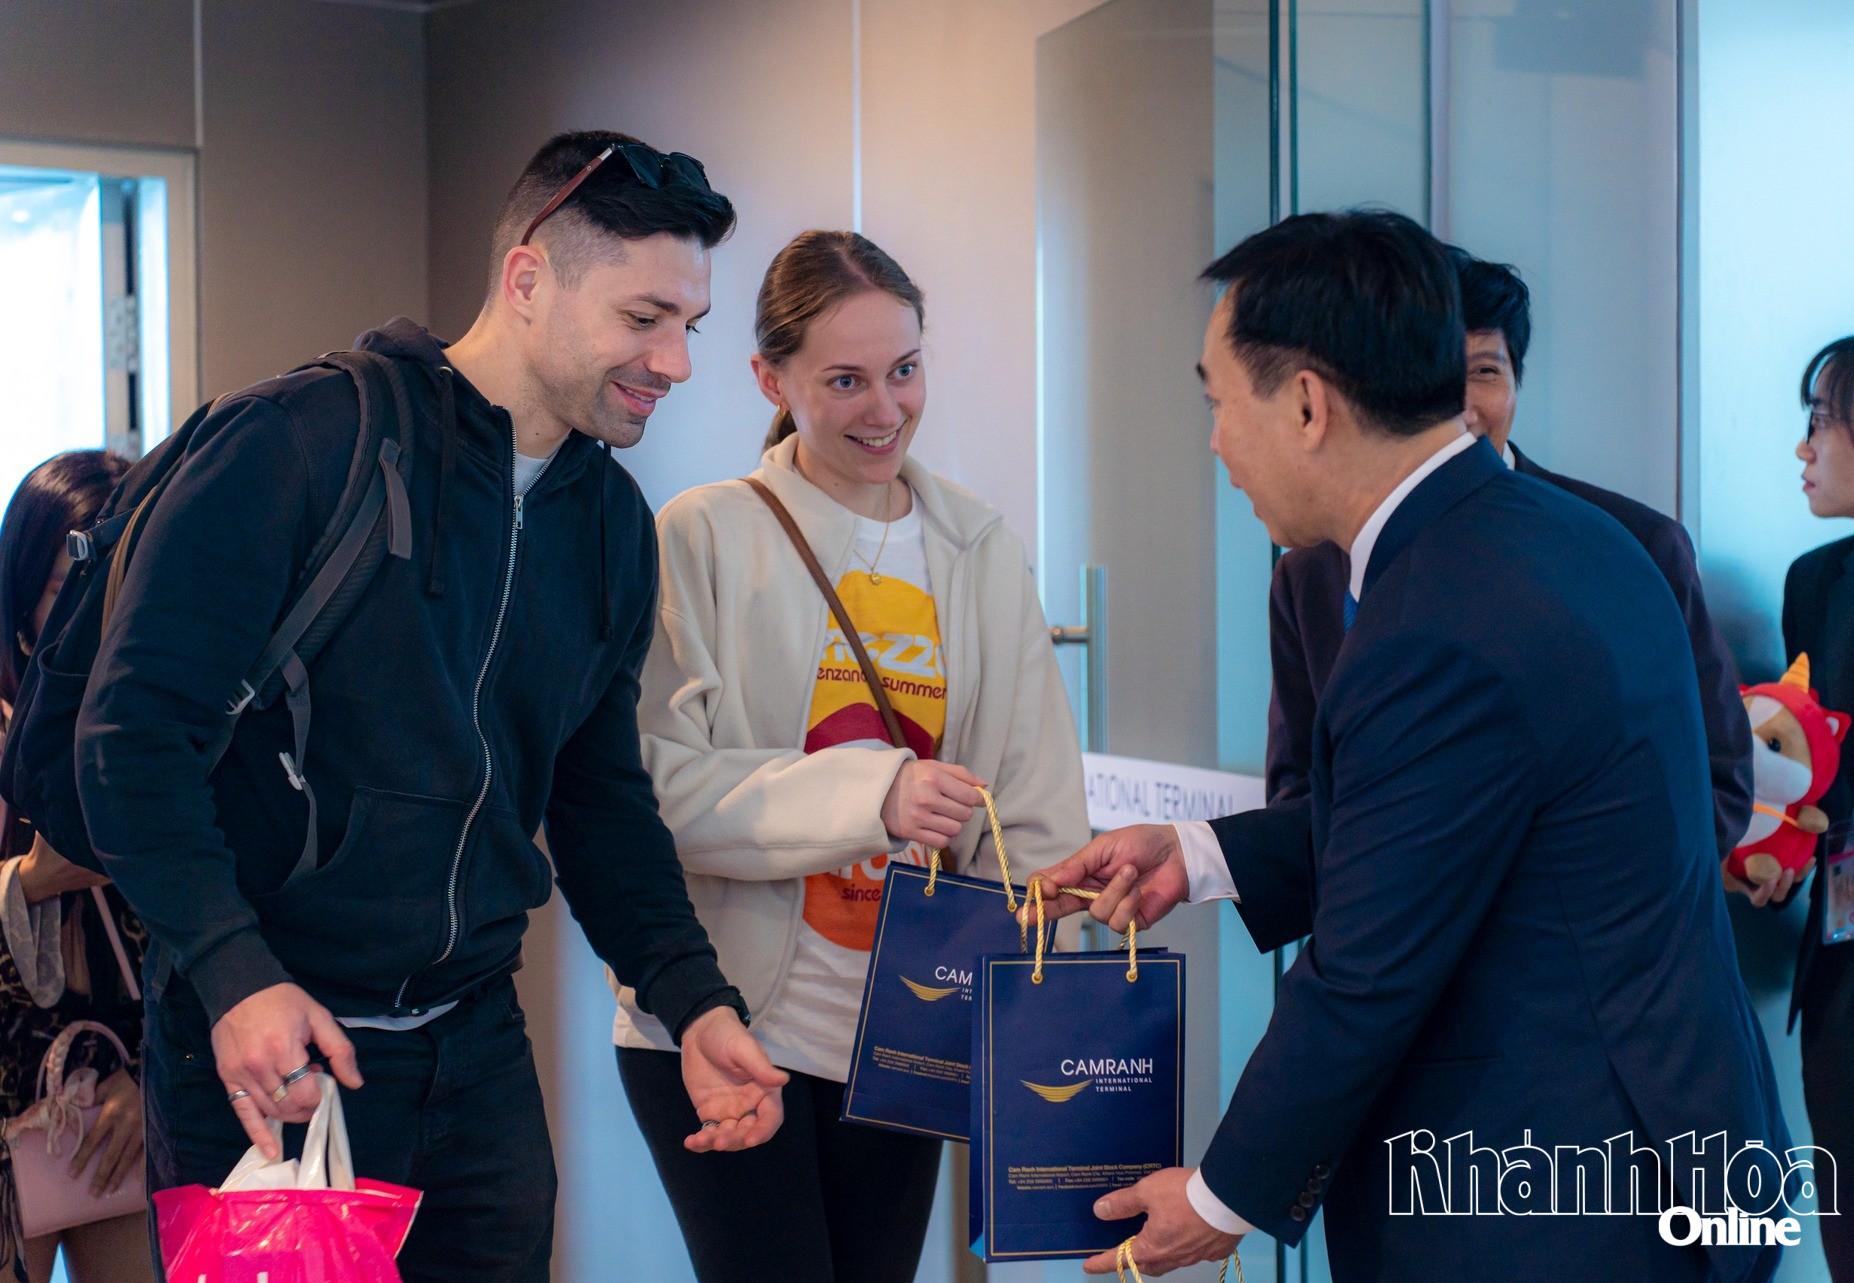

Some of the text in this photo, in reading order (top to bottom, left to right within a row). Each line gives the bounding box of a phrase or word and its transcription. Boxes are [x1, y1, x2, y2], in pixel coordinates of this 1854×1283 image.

[817, 667, 867, 683] enzan
[841, 883, 881, 901] since
[935, 966, 973, 986] CAM
[1061, 1058, 1153, 1076] CAMRANH
